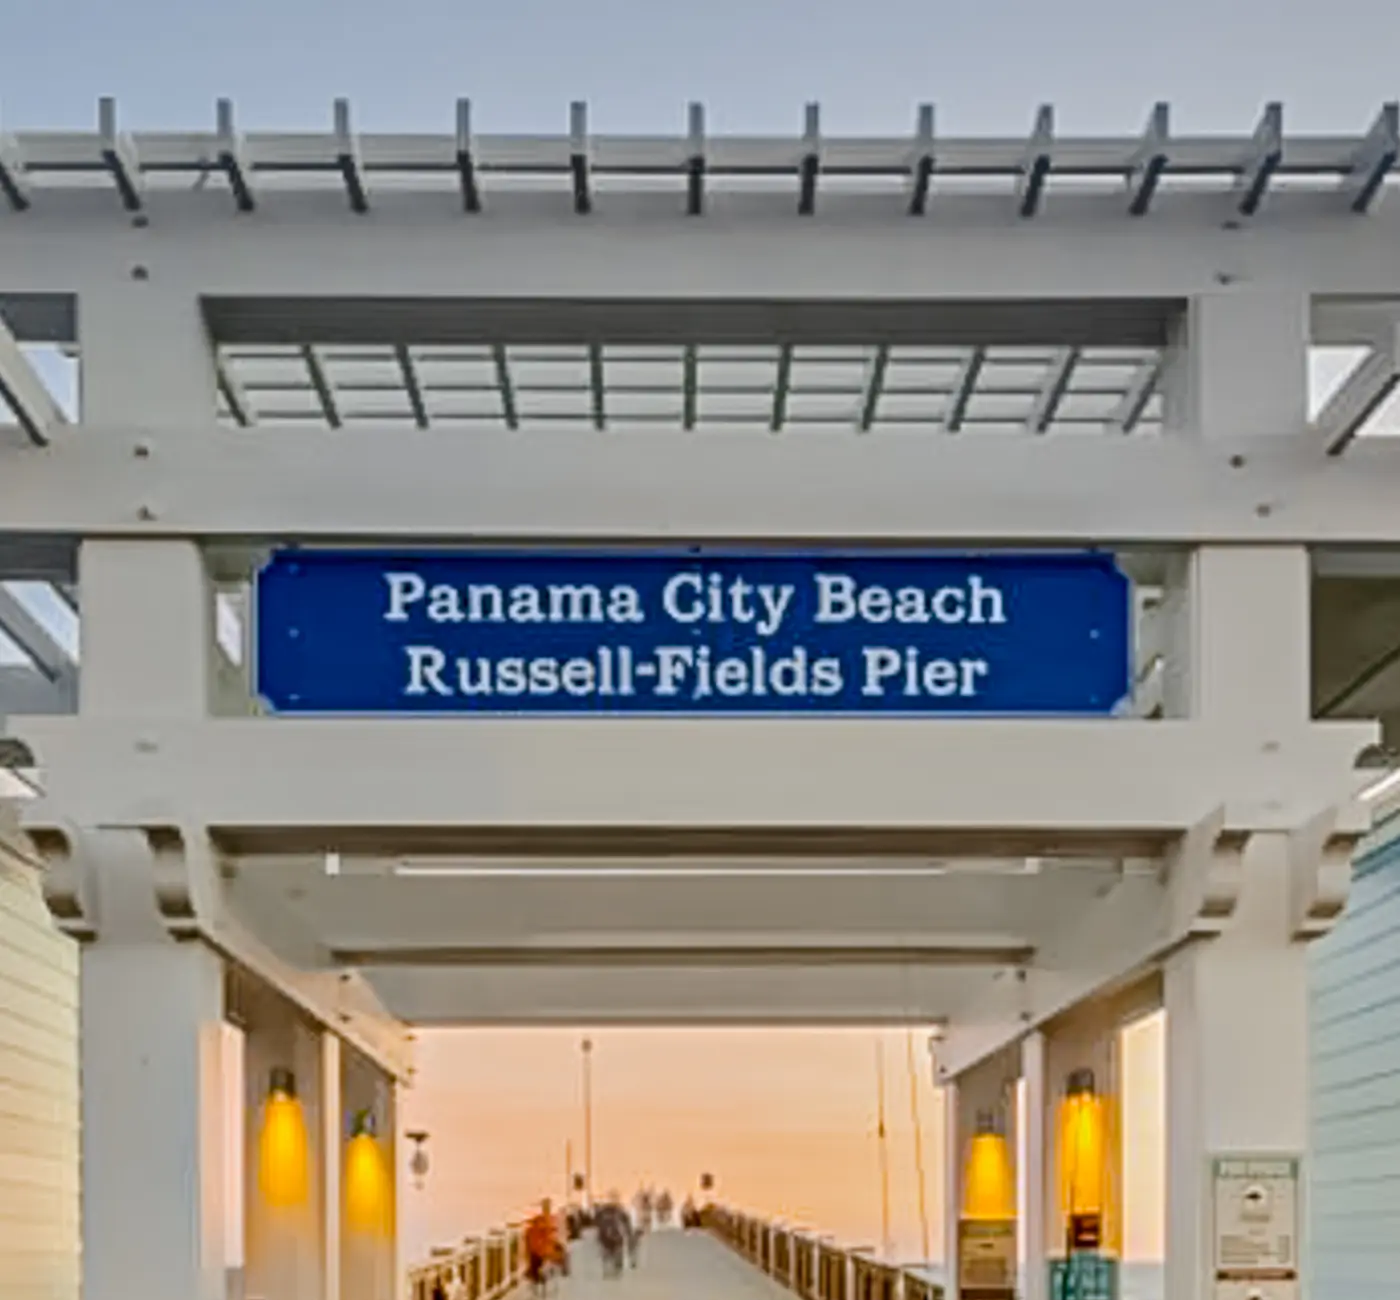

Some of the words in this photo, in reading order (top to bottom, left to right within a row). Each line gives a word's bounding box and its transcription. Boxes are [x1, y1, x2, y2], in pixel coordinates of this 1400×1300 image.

[384, 573, 645, 622] Panama
[662, 572, 794, 635] City
[815, 574, 1006, 623] Beach
[406, 645, 844, 695] Russell-Fields
[862, 646, 988, 695] Pier
